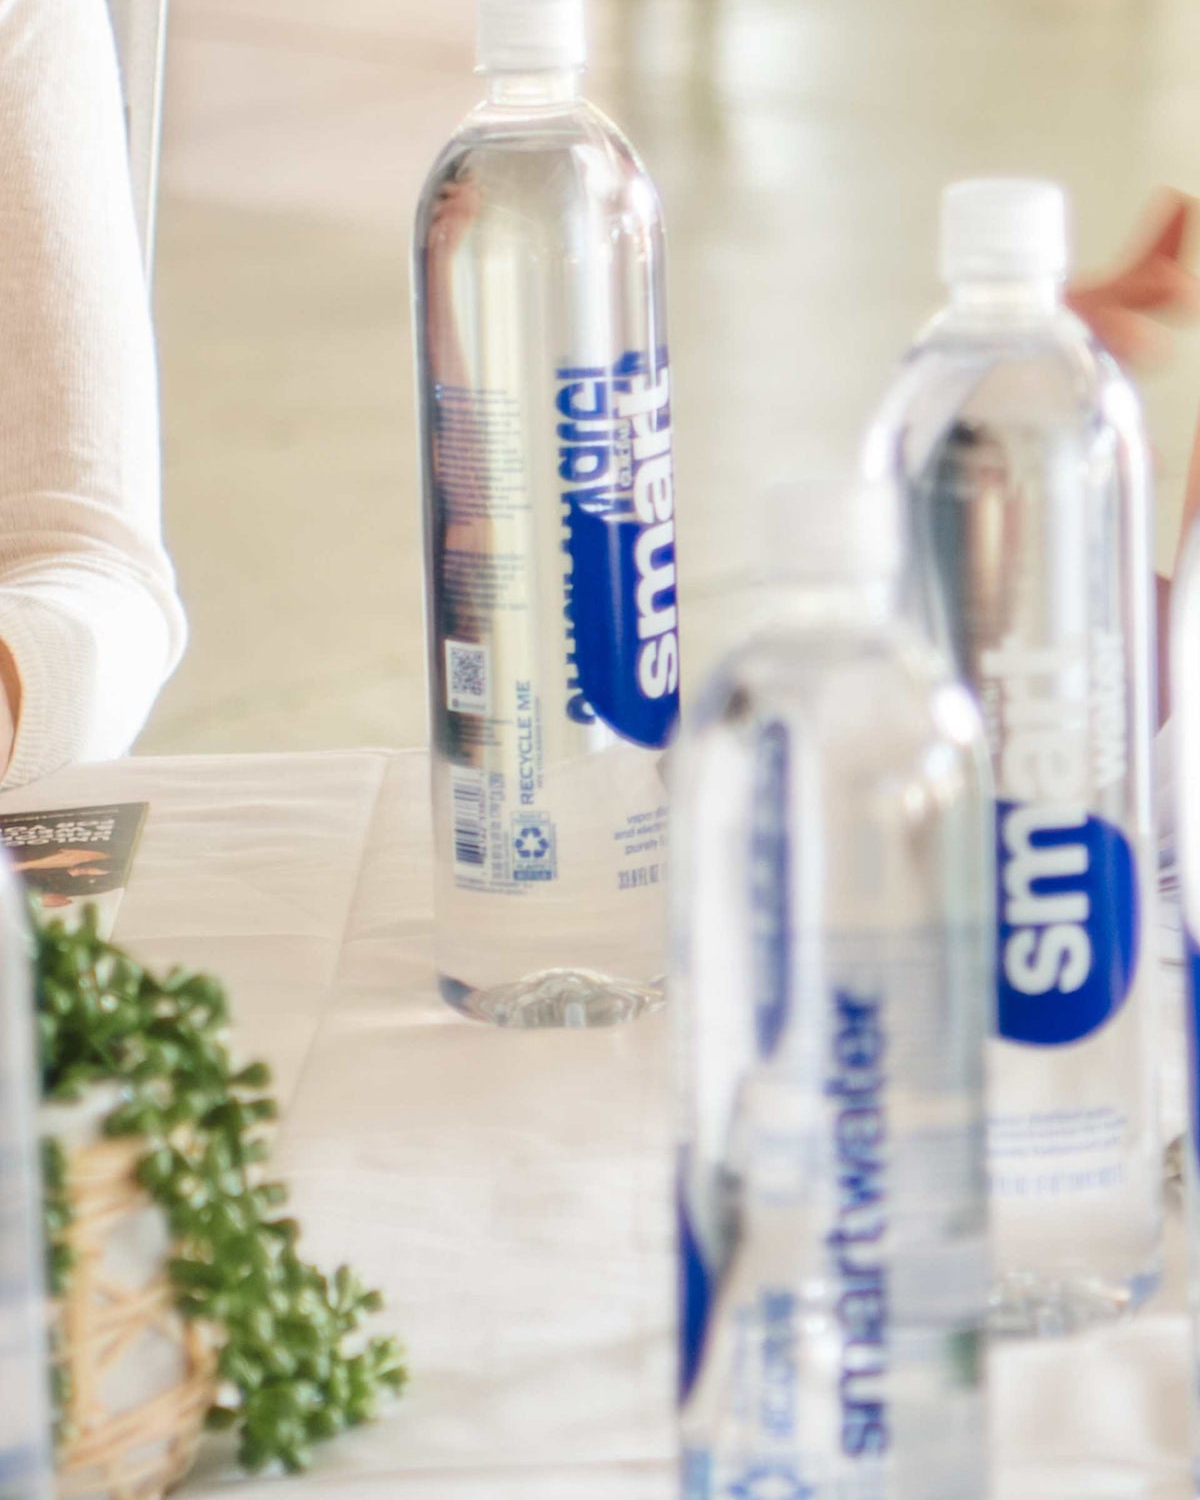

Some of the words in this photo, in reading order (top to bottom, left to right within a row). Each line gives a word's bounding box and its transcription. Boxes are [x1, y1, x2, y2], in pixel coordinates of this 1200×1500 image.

[618, 366, 675, 699] smart
[515, 680, 531, 711] ME
[517, 716, 534, 805] RECYCLE
[825, 987, 890, 1457] smartwater
